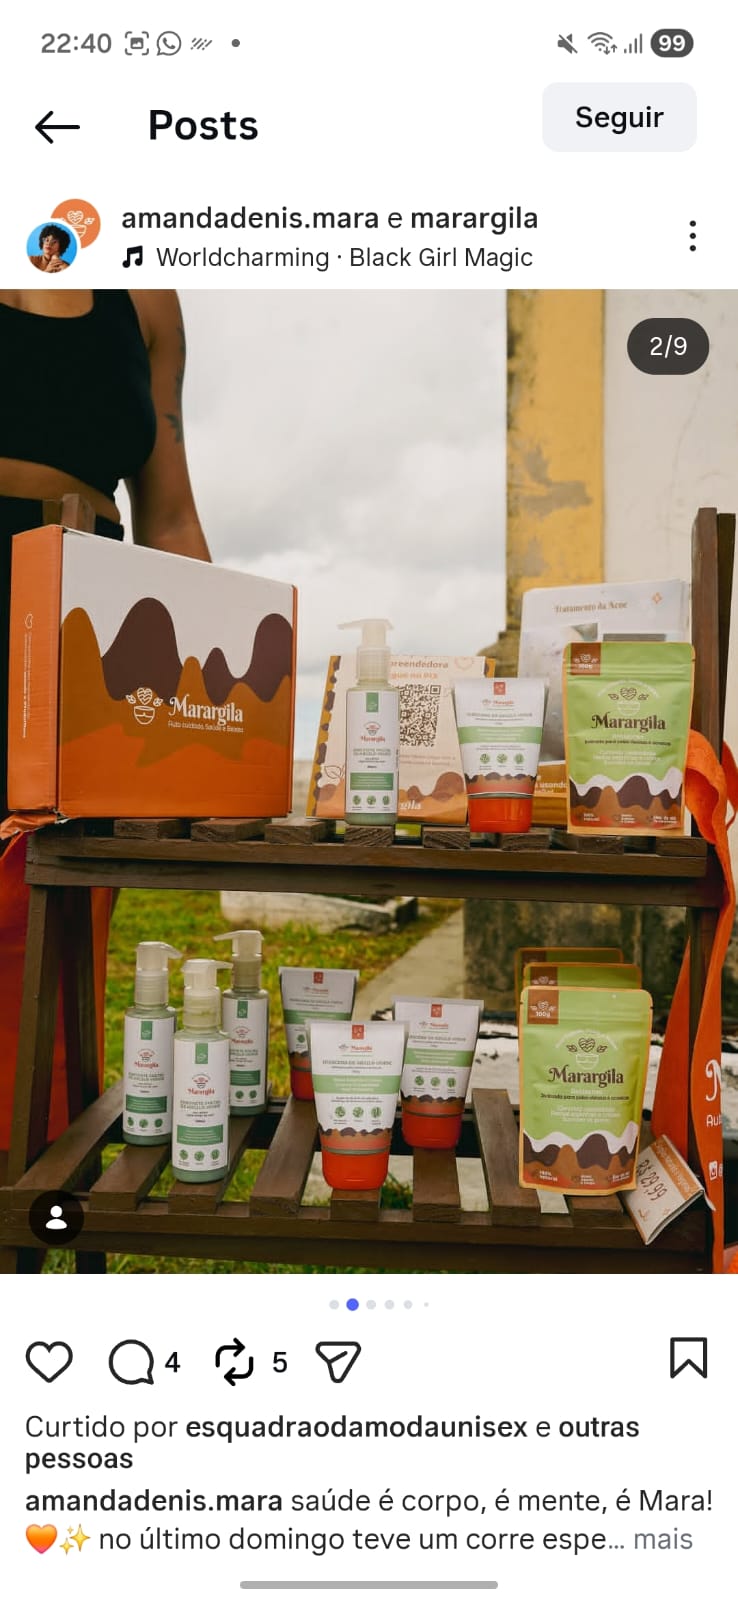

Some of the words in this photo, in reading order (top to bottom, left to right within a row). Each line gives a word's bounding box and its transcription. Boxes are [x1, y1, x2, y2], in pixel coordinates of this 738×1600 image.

[168, 693, 244, 726] Marargila
[591, 711, 666, 733] Marargila
[535, 1011, 551, 1020] 100g
[548, 1063, 624, 1088] Marargila
